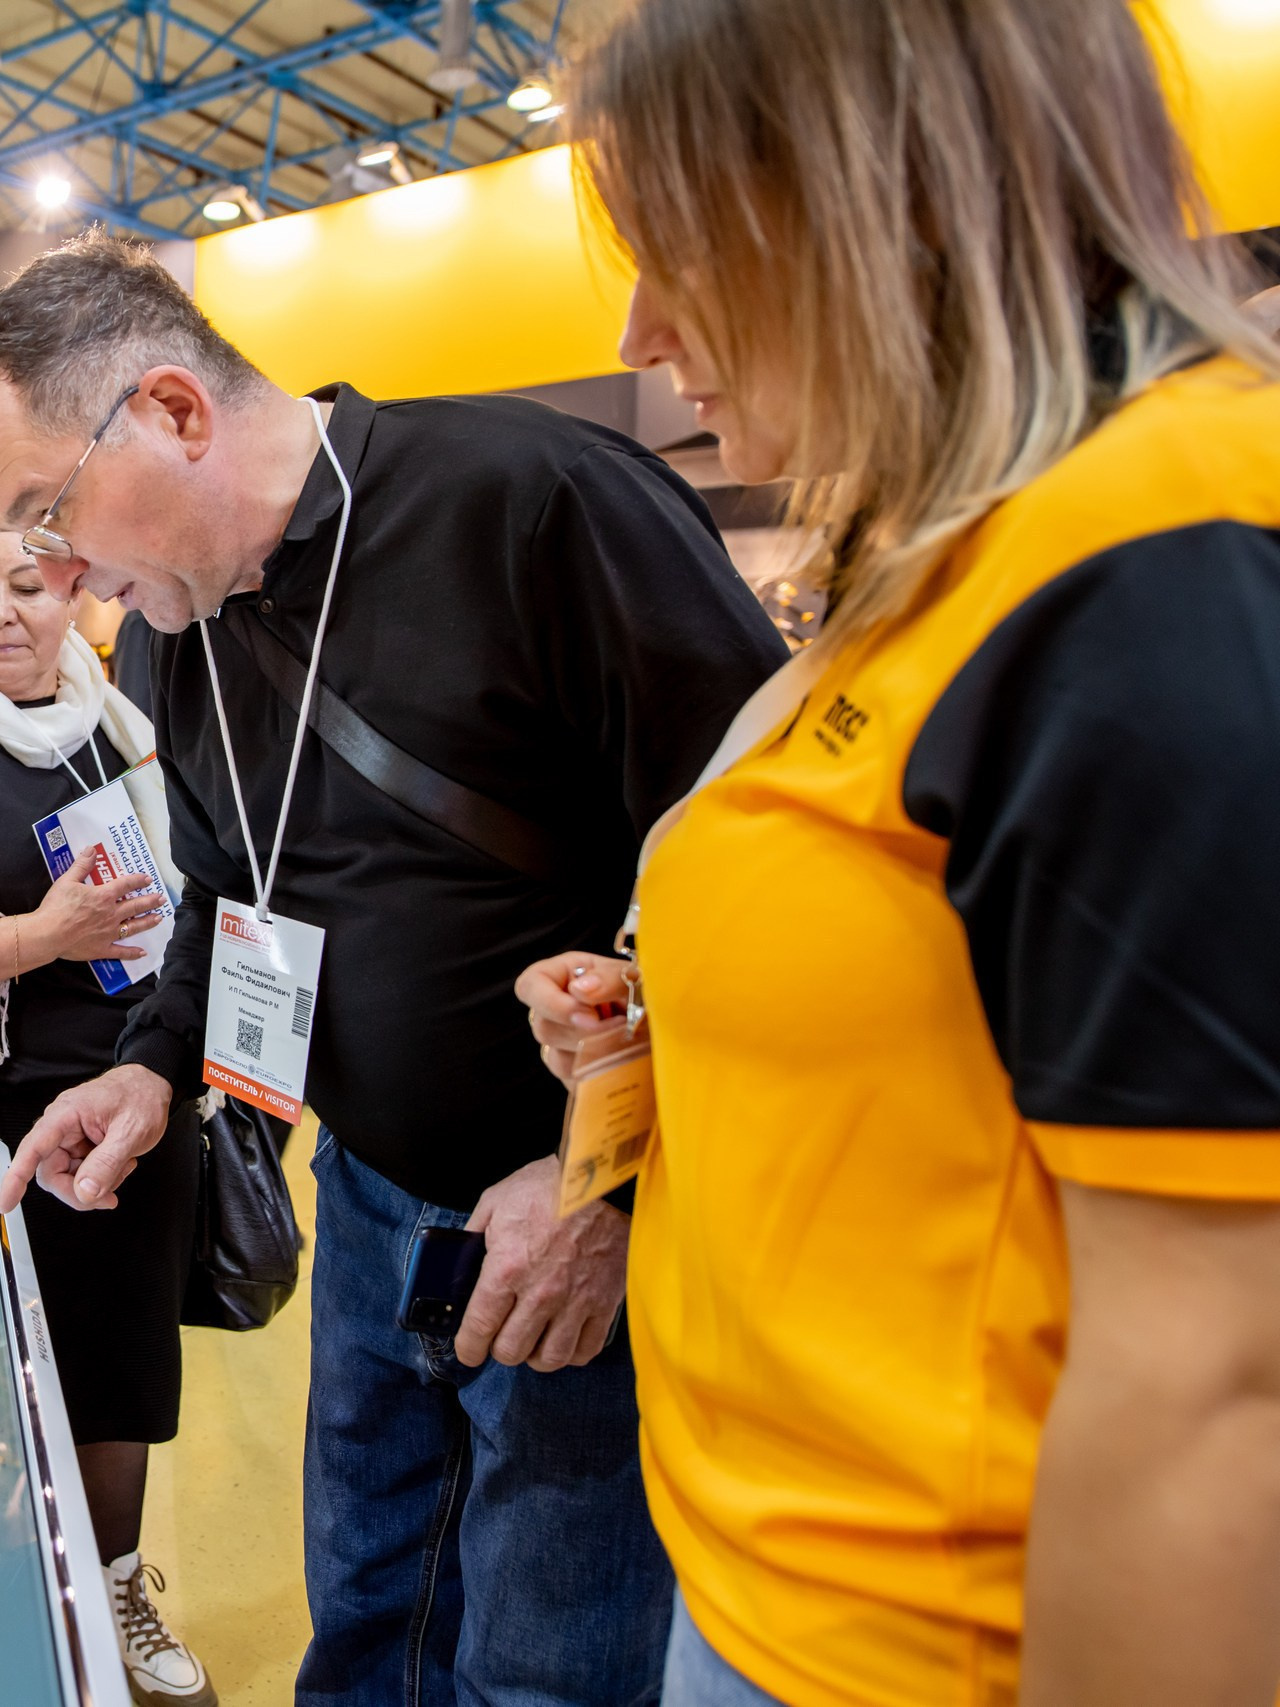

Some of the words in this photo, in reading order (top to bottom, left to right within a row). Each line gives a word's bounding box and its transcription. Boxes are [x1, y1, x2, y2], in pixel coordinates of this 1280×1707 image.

[223, 917, 267, 944] mitex
[236, 961, 276, 981] Гильманов
[208, 1066, 258, 1096] ПОСЕТИТЕЛЬ
[264, 1091, 296, 1114] VISITOR
